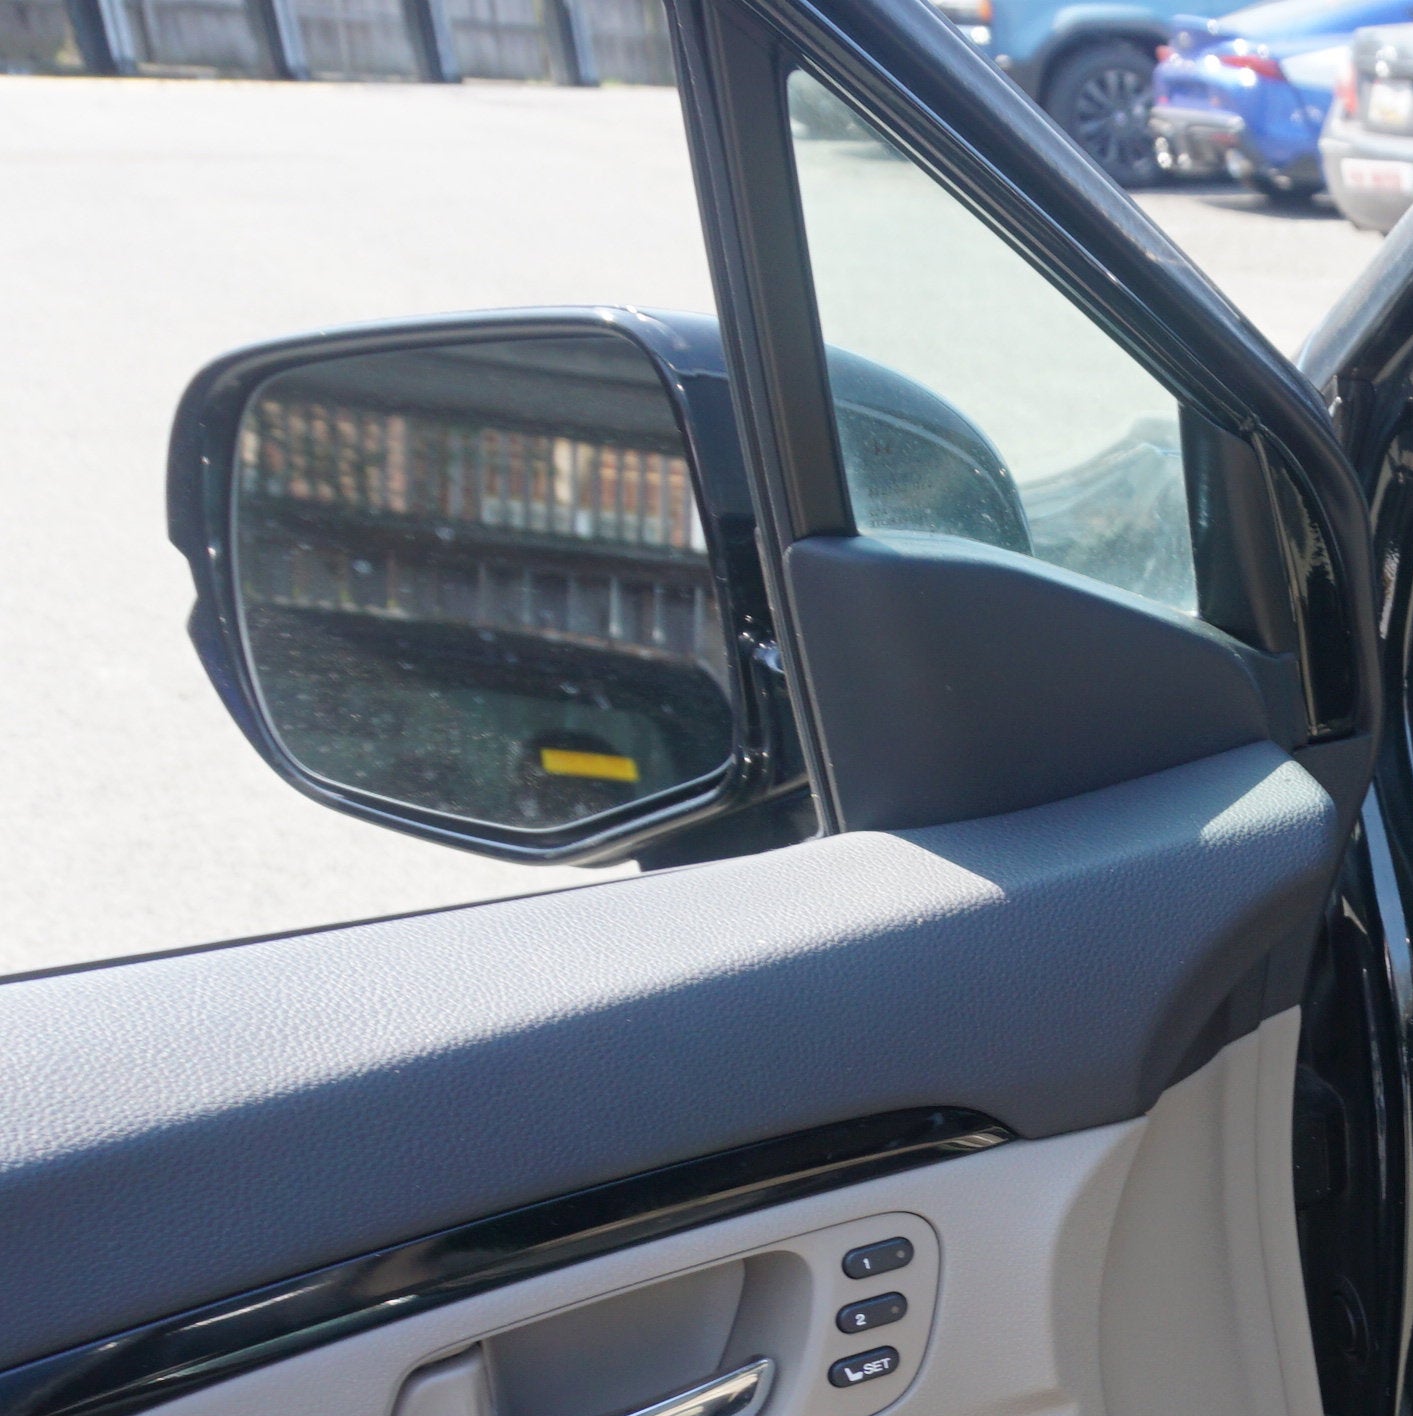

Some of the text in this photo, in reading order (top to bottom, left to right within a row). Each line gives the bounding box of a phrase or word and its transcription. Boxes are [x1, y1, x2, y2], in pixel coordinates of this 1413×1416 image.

[862, 1258, 871, 1269] 1
[855, 1313, 867, 1325] 2
[863, 1358, 892, 1375] SET
